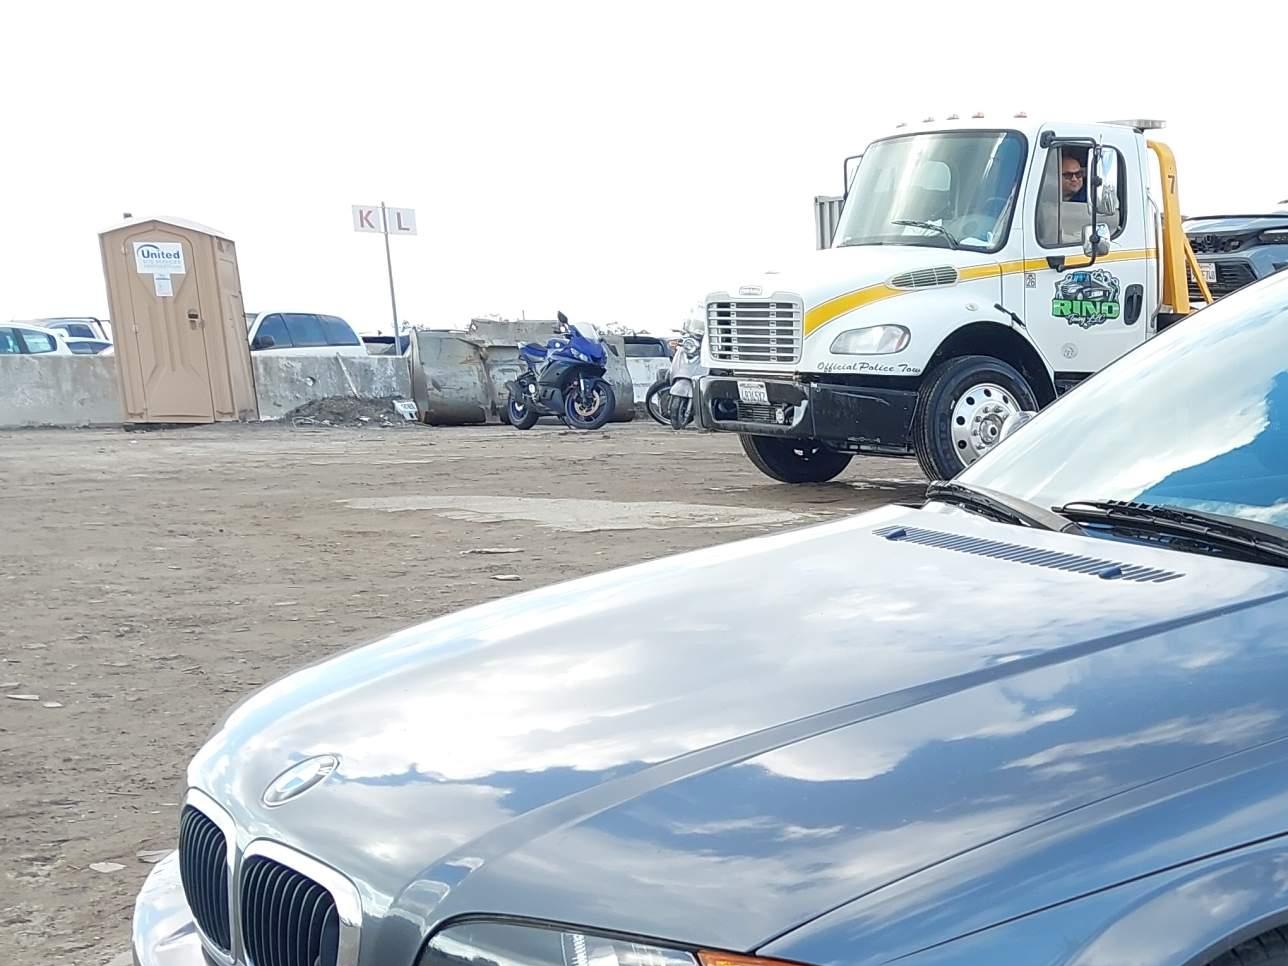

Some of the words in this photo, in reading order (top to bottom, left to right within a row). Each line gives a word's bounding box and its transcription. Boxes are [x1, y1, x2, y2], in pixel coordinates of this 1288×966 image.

[1167, 174, 1175, 194] 7
[359, 209, 375, 229] K
[397, 212, 411, 231] L
[141, 249, 180, 259] United
[1052, 299, 1120, 318] RINO
[1066, 313, 1086, 326] Towing
[1086, 313, 1106, 324] LLC
[817, 361, 858, 373] Official
[859, 361, 895, 372] Police
[897, 363, 921, 374] Tow
